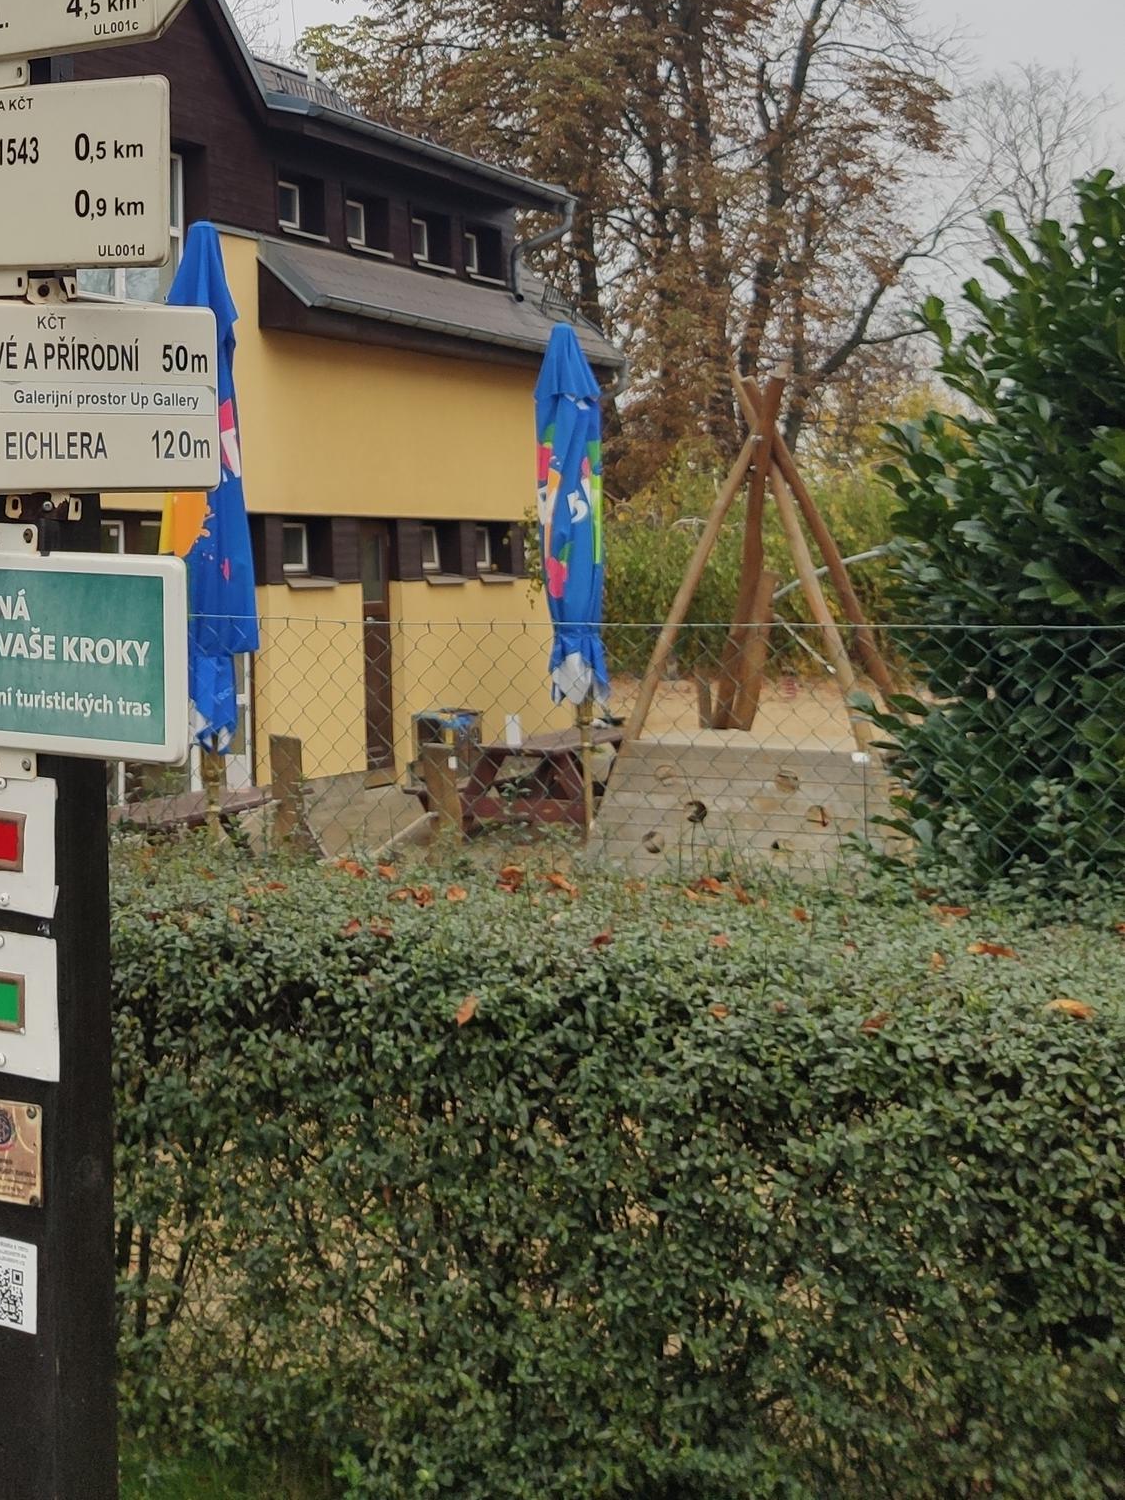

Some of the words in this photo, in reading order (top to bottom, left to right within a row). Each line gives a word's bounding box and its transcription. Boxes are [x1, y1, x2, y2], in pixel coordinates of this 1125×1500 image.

[93, 20, 139, 36] UL001c
[8, 98, 33, 112] KČT
[74, 133, 107, 164] 0,5
[114, 140, 144, 159] km
[74, 189, 107, 220] 0,9
[115, 198, 145, 217] km
[98, 244, 145, 258] UL001d
[36, 312, 67, 331] KČT
[24, 343, 38, 370] A
[44, 335, 140, 373] PŘÍRODNÍ
[13, 389, 73, 408] Galerijní
[76, 392, 126, 410] prostor
[130, 392, 149, 409] Up
[153, 392, 200, 411] Gallery
[5, 431, 108, 460] EICHLERA
[151, 430, 211, 460] 120m
[63, 636, 151, 667] KROKY
[16, 688, 114, 718] turistických
[118, 696, 151, 717] tras
